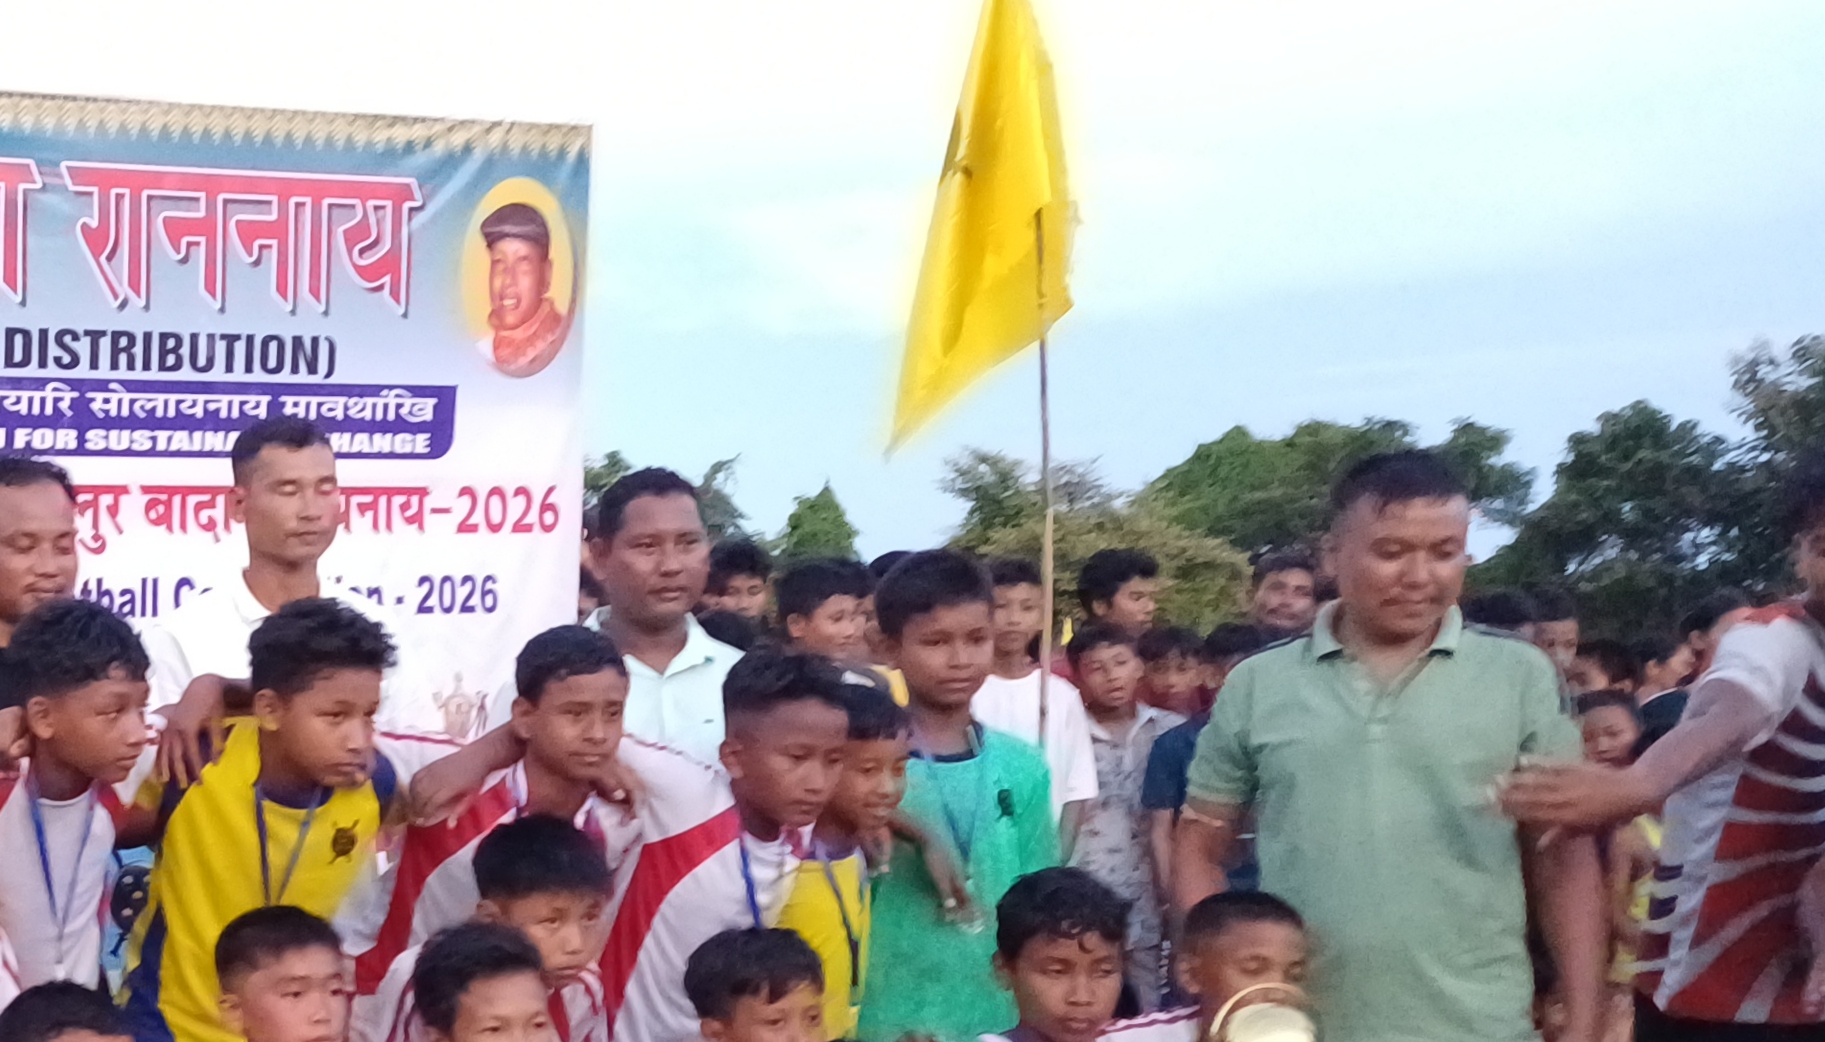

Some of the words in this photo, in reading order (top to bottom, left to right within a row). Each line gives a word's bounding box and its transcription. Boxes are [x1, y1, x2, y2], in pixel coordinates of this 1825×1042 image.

[60, 160, 426, 317] राननाय
[4, 326, 337, 379] DISTRIBUTION)
[85, 382, 272, 420] सोलायनाय
[13, 427, 77, 450] FOR
[84, 428, 239, 453] SUSTAIN
[329, 432, 431, 454] HANGE
[416, 573, 499, 615] 2026
